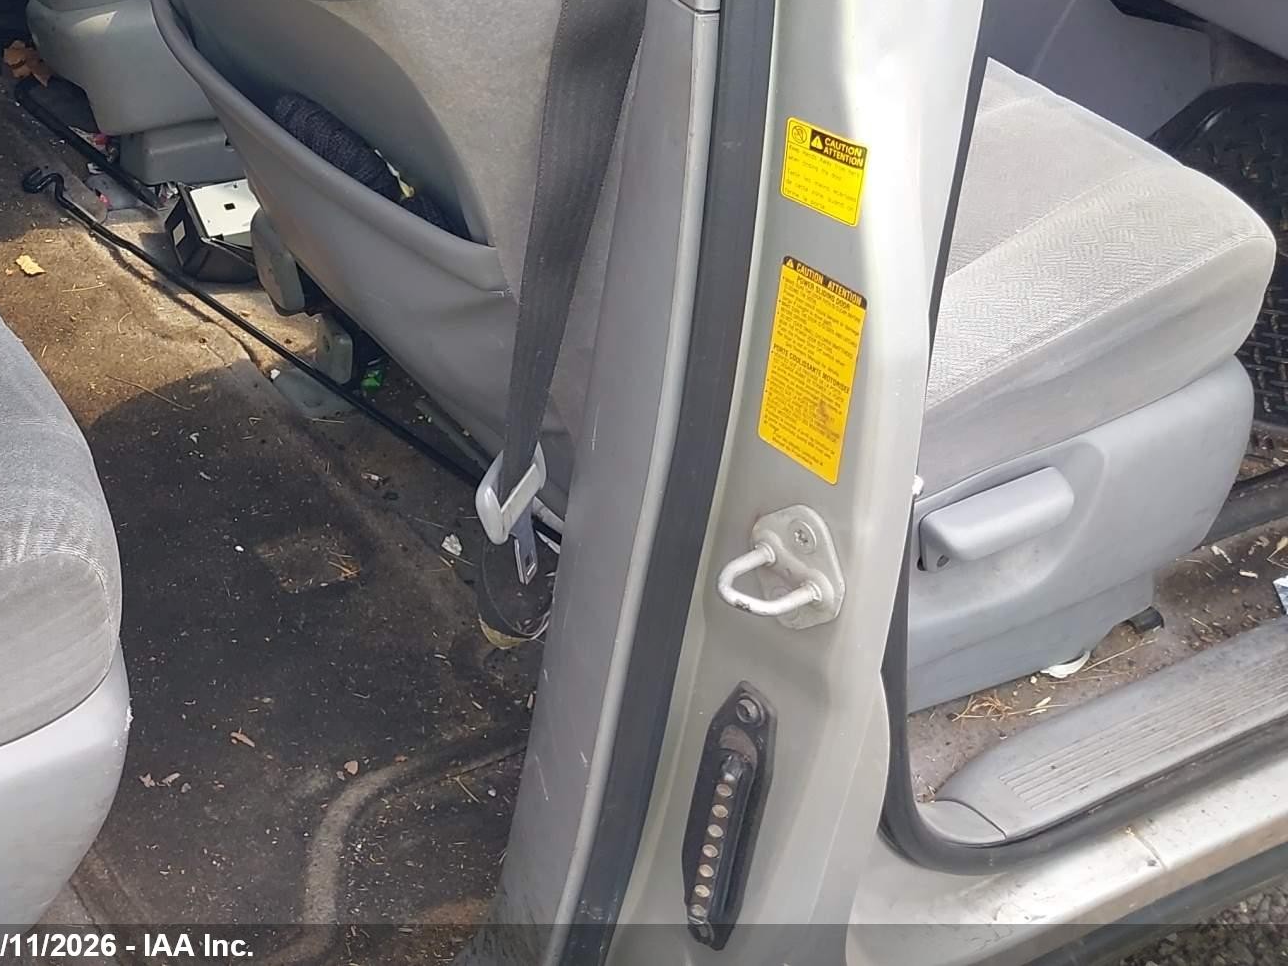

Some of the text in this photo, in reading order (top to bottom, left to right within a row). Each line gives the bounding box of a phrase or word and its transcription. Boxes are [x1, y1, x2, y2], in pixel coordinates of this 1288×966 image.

[823, 146, 864, 168] ATTENTION
[824, 137, 863, 158] CAUTION
[796, 262, 862, 306] CAUTION ATTENTION
